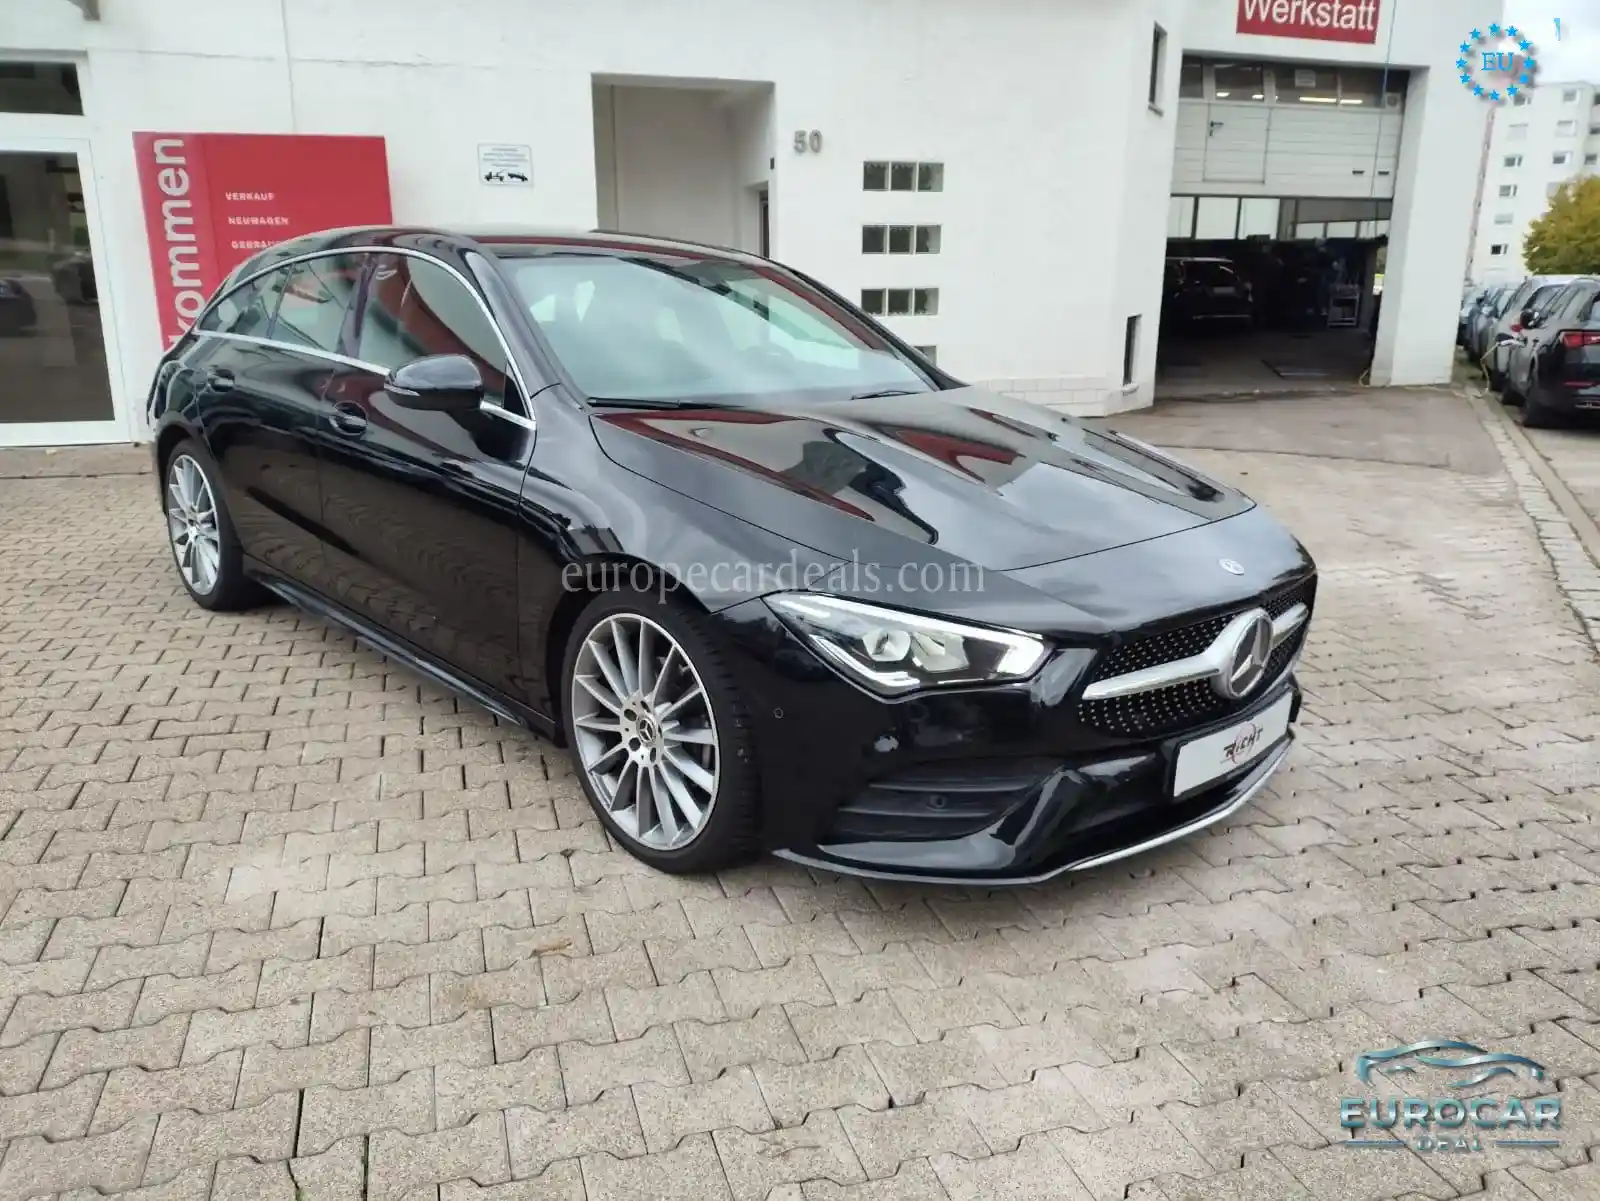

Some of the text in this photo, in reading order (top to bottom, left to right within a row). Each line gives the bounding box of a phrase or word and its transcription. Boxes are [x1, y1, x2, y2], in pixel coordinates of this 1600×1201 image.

[1243, 0, 1376, 30] Werkstatt
[794, 130, 822, 153] 50
[225, 192, 275, 200] VERKAUF
[228, 216, 289, 225] NEUWAGEN
